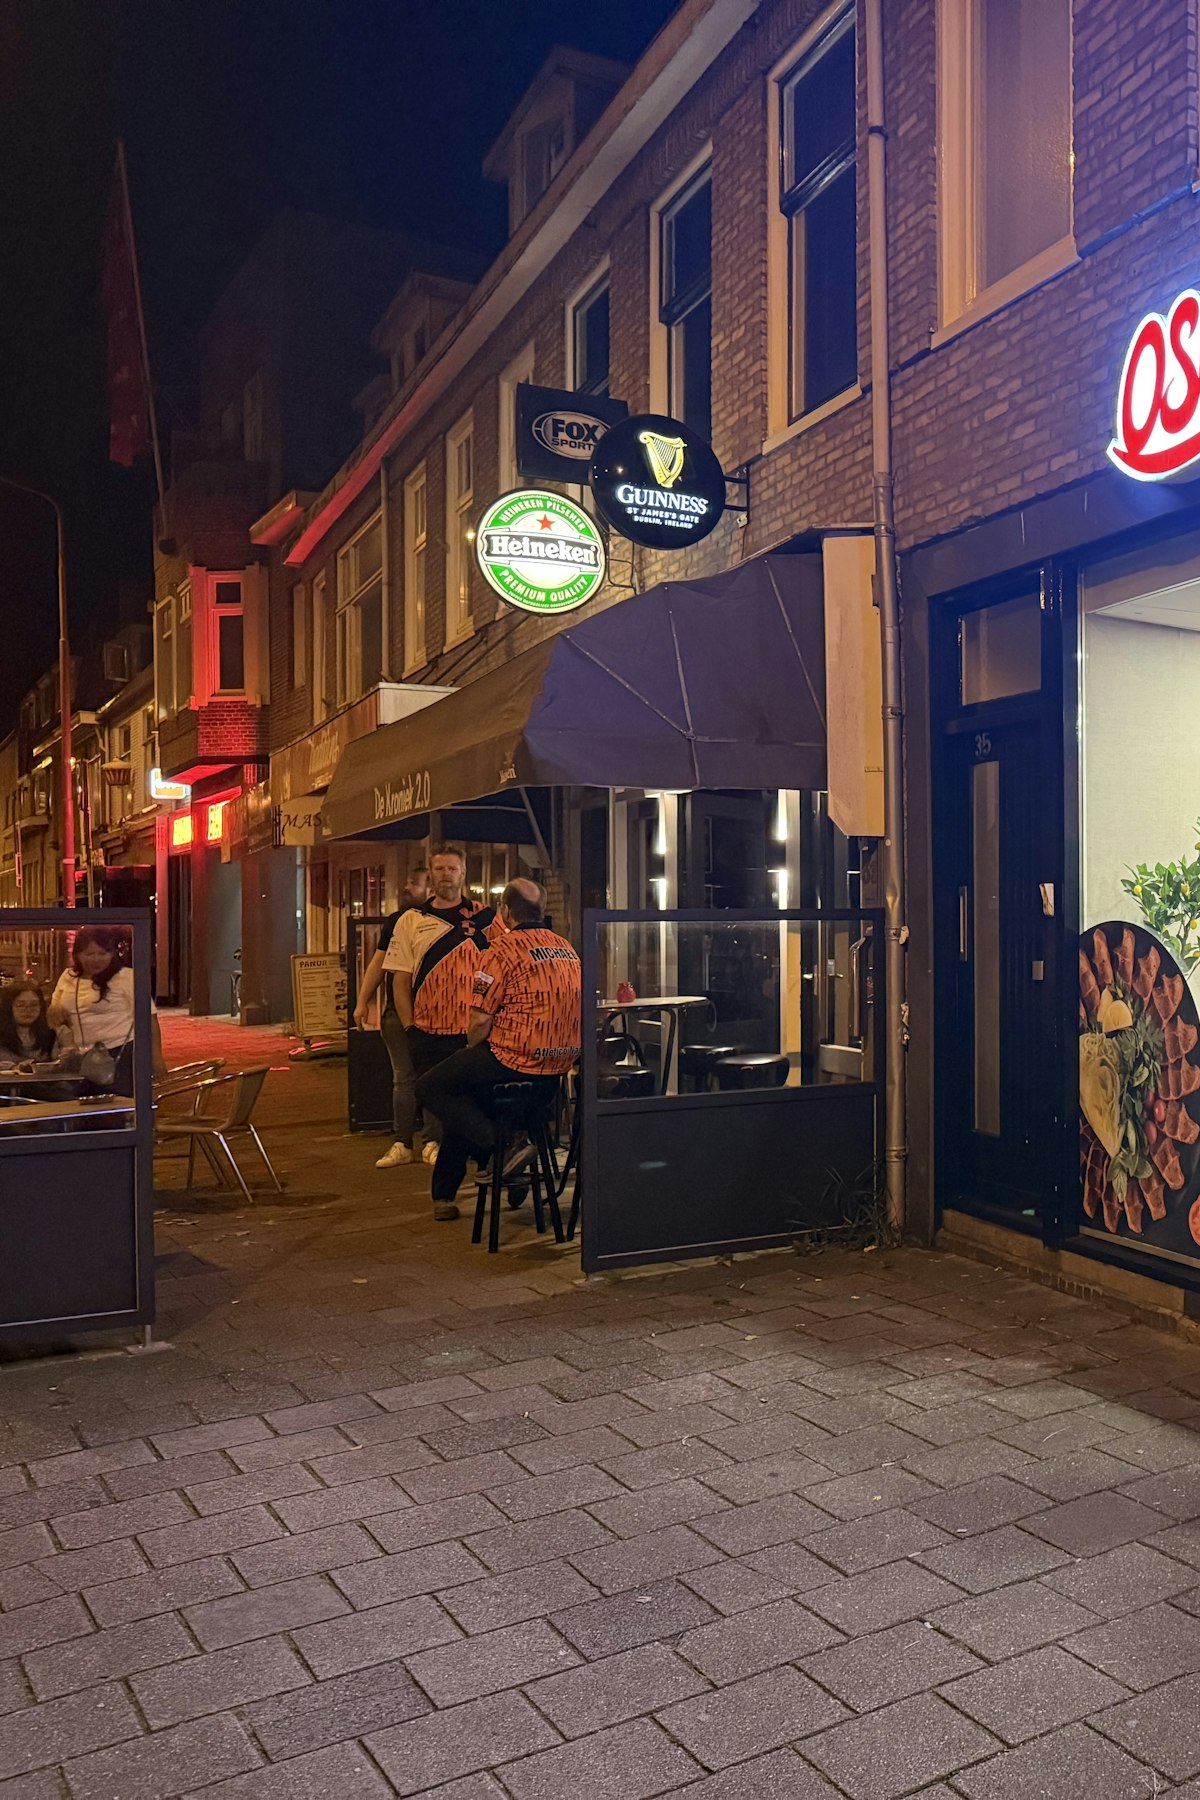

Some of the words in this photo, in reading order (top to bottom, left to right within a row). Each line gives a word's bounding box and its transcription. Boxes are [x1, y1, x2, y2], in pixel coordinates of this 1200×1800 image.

[551, 418, 599, 443] FOX
[551, 437, 595, 451] SPORT
[617, 484, 709, 515] GUINNESS
[499, 499, 544, 523] HEINEKEN
[546, 501, 587, 531] PILSENER
[626, 506, 639, 515] ST
[641, 508, 677, 520] JAMES'S
[679, 513, 700, 524] GATE
[664, 519, 693, 529] IRELAND
[490, 535, 597, 565] Heineken
[499, 570, 546, 602] PREMIUM
[550, 576, 588, 602] QUALITY
[374, 786, 384, 820] De
[385, 774, 414, 817] Kroniek
[414, 769, 431, 810] 2.0
[529, 947, 579, 962] MICHAEL
